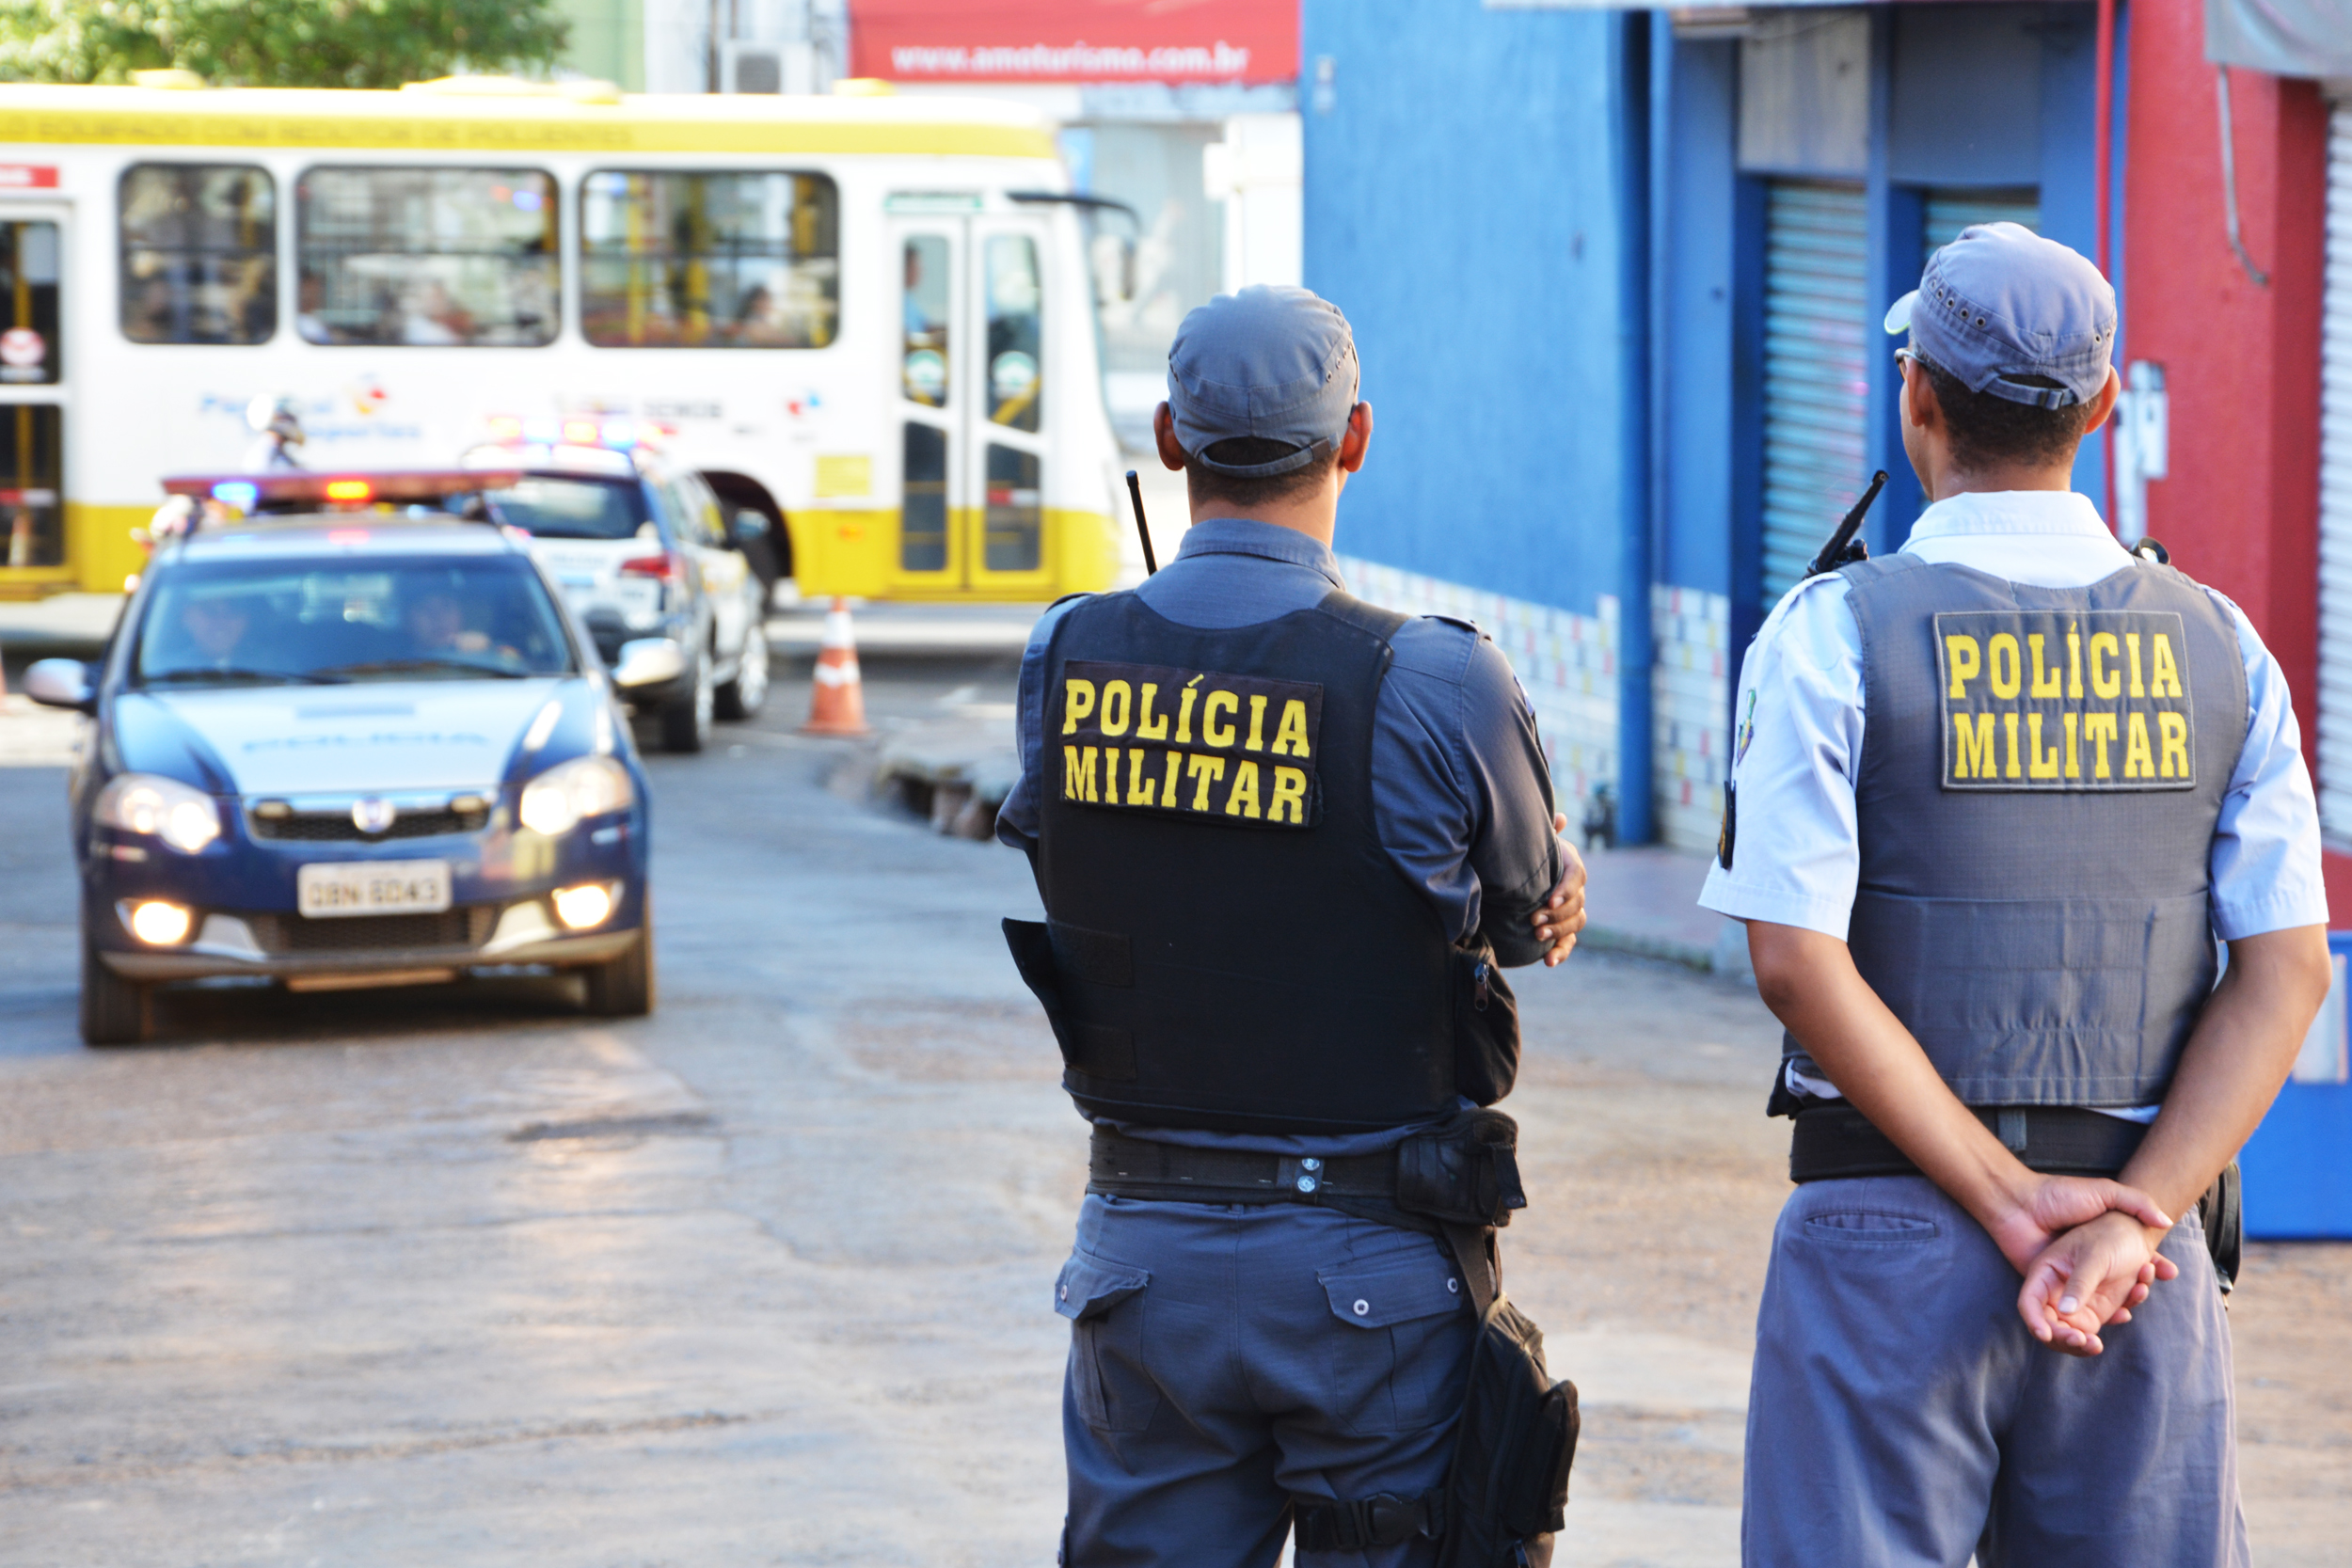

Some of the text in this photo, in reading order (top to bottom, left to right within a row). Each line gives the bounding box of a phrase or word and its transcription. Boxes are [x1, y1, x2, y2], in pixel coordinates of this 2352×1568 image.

[891, 40, 1250, 74] www.amoturismo.com.br
[1946, 621, 2183, 699] POLÍCIA
[1062, 673, 1310, 758] POLÍCIA
[1954, 711, 2189, 779] MILITAR
[1064, 745, 1307, 824] MILITAR
